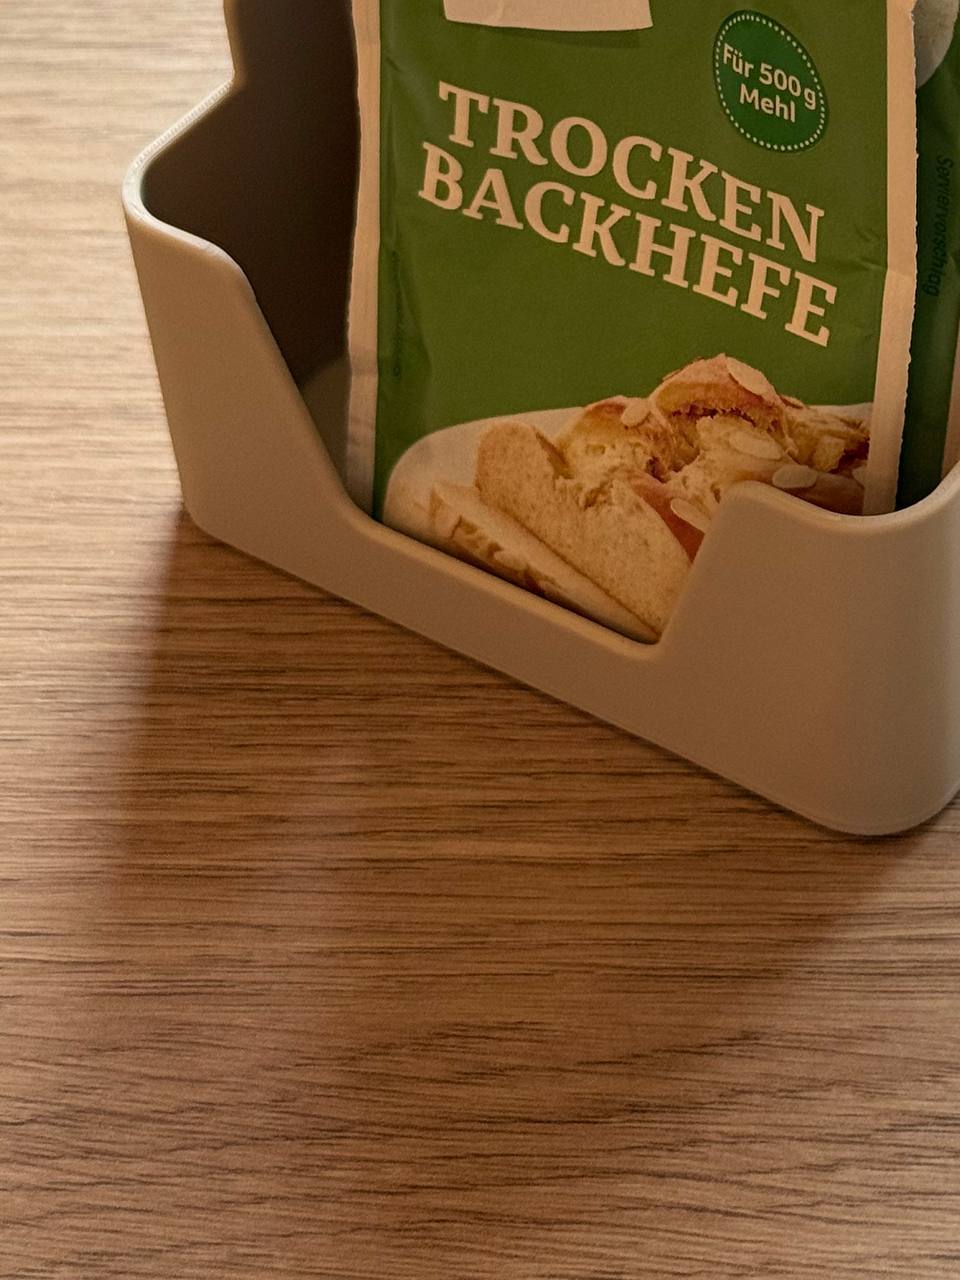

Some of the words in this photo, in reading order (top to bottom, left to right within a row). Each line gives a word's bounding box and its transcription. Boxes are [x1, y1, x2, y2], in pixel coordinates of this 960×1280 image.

[723, 43, 754, 78] Für
[740, 83, 796, 123] Mehl
[438, 81, 824, 263] TROCKEN
[923, 154, 954, 297] Serviervorschlag
[418, 142, 837, 347] BACKHEFE
